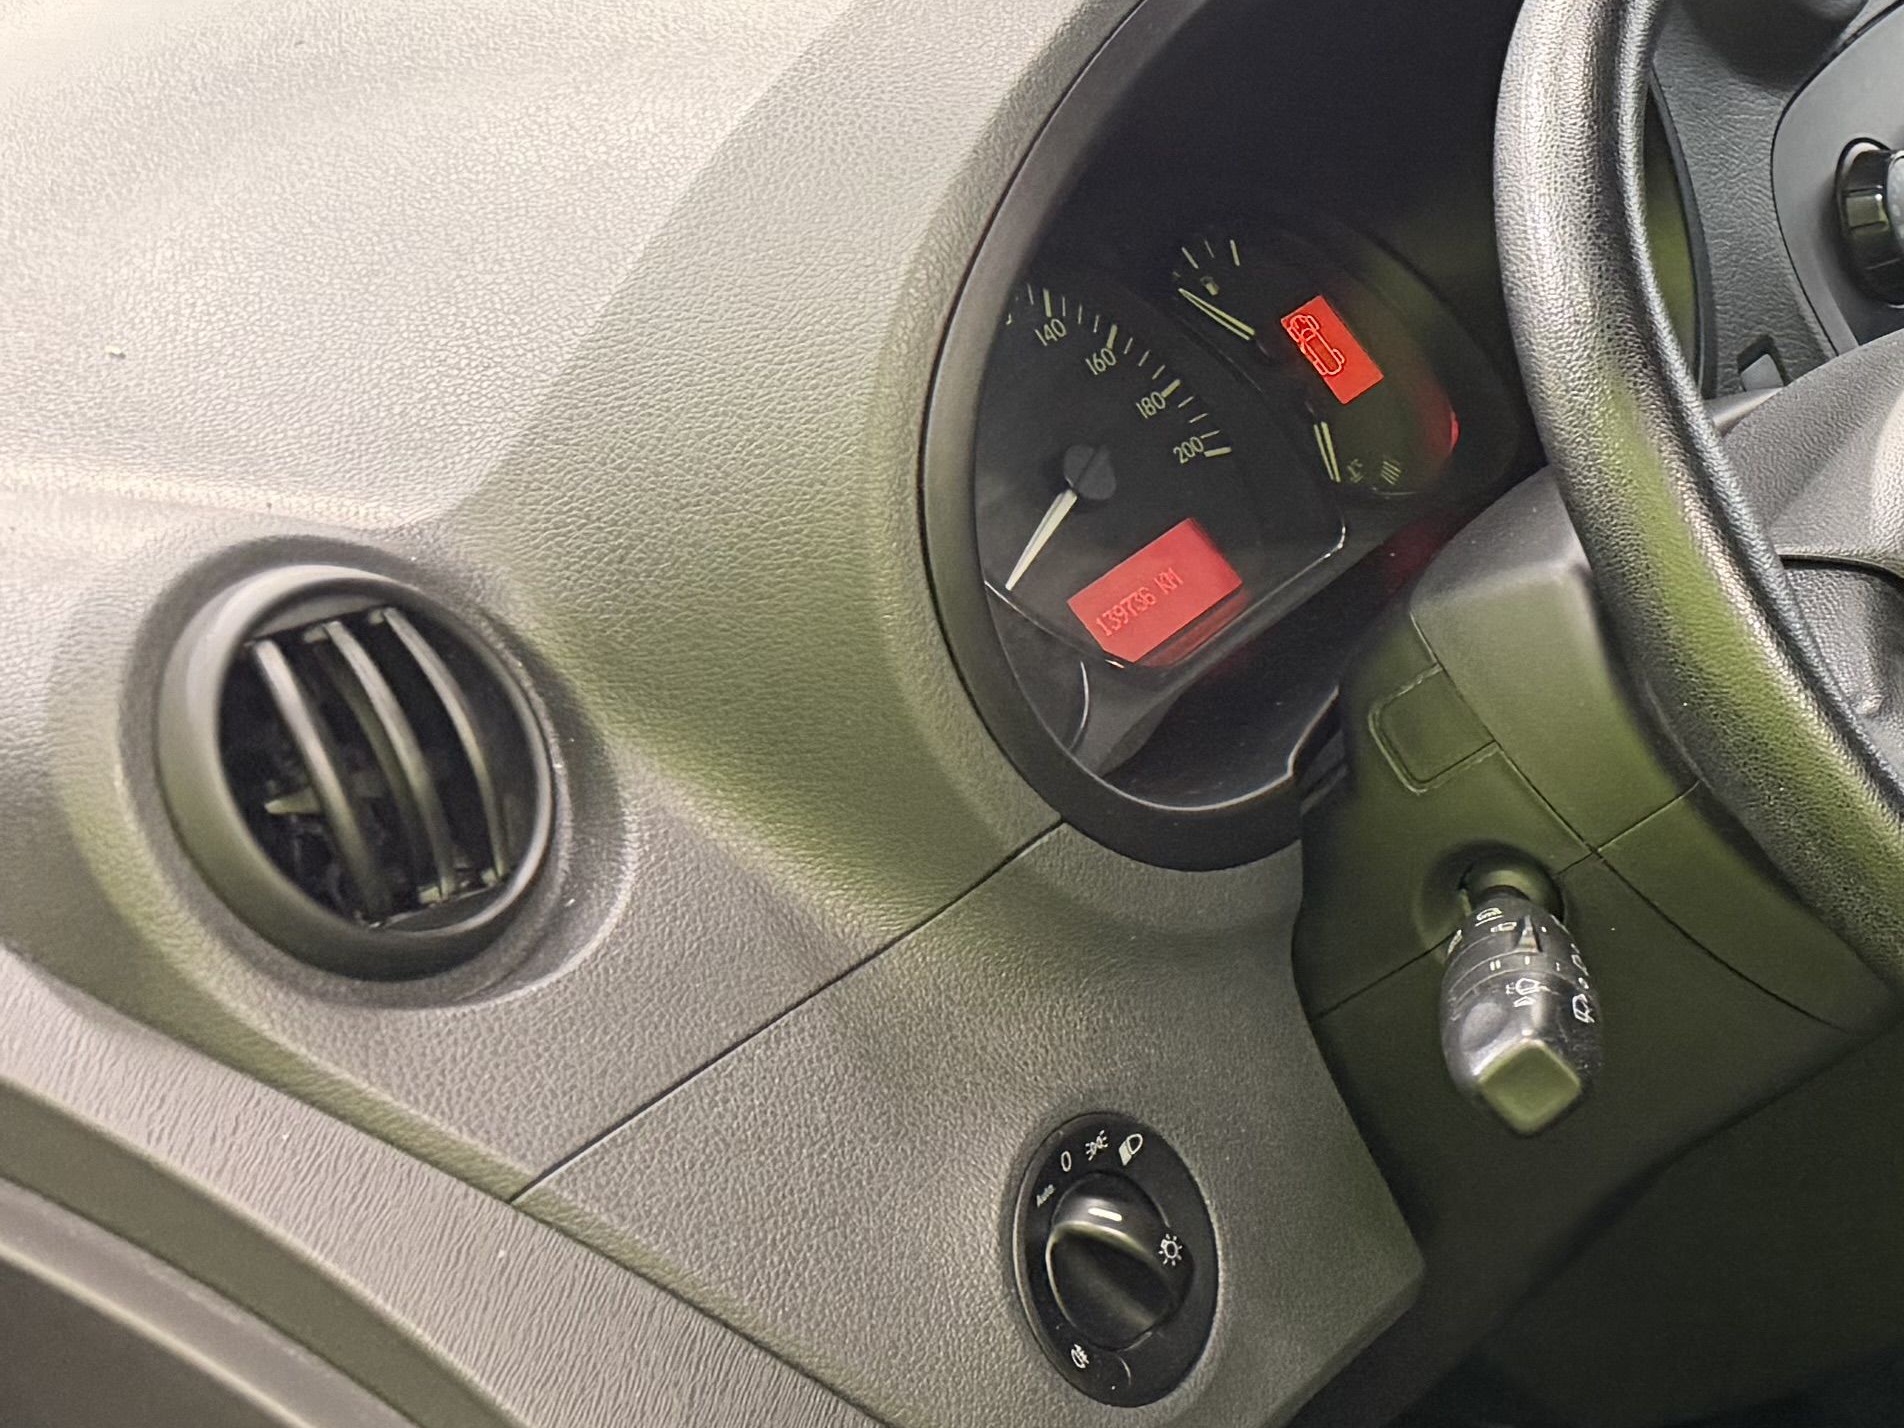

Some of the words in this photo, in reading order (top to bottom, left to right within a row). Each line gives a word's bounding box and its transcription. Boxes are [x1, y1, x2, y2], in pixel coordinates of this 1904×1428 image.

[1034, 318, 1068, 346] 140
[1085, 347, 1117, 375] 160
[1135, 391, 1166, 419] 180
[1172, 436, 1204, 464] 200
[1096, 586, 1157, 637] 139736
[1153, 567, 1184, 595] KM
